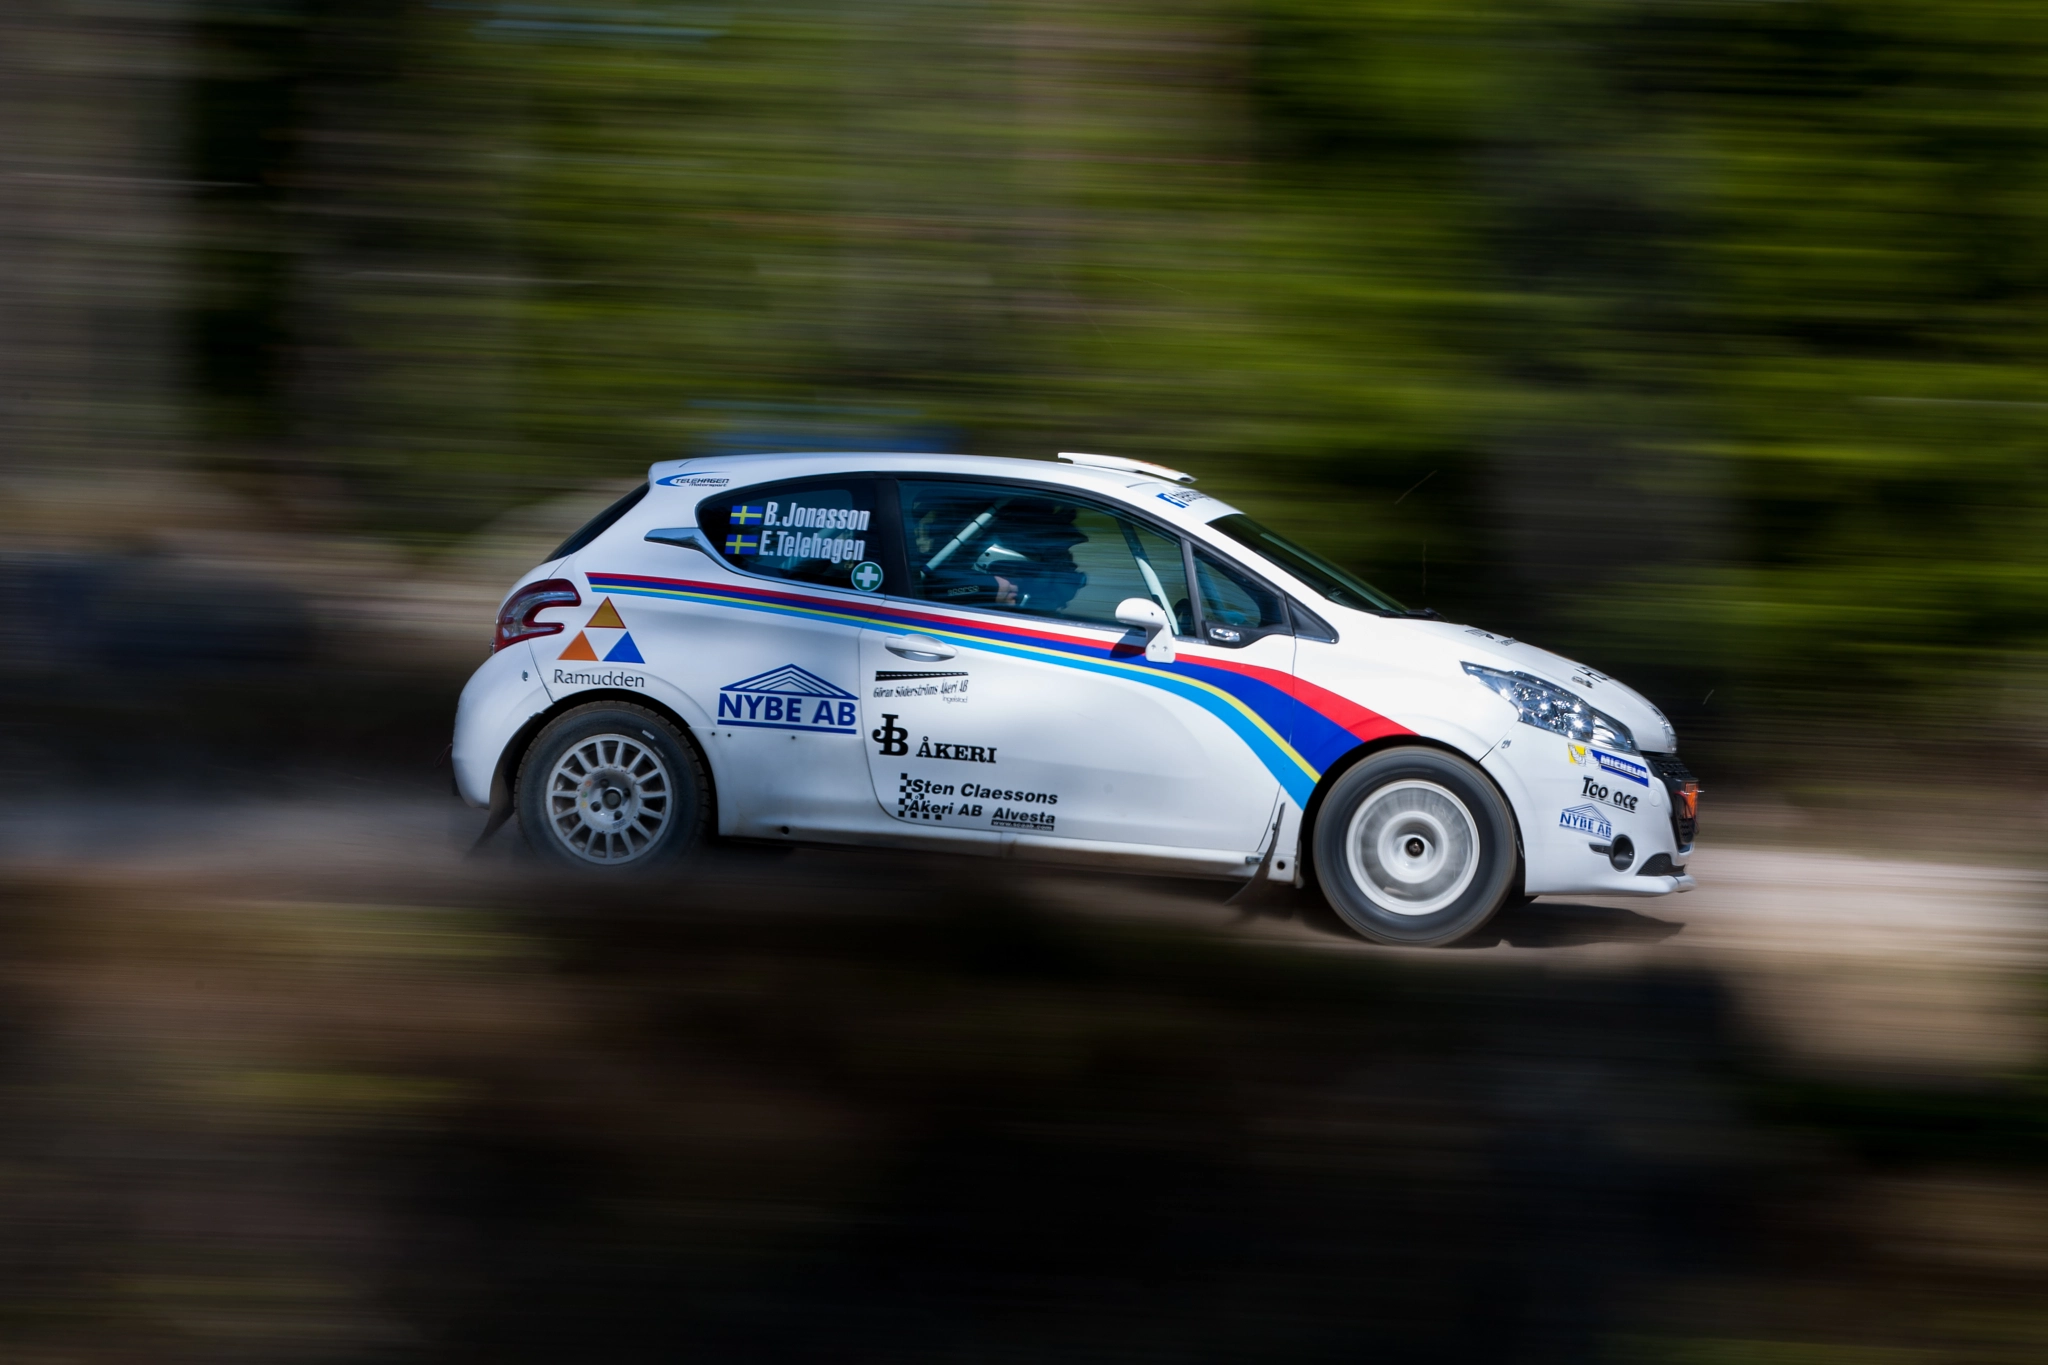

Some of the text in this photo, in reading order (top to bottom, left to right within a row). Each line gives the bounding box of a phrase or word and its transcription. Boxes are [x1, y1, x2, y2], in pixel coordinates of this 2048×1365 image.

[553, 668, 645, 688] Ramudden
[718, 693, 856, 726] NYBE AB
[916, 736, 997, 764] ÅKERI
[1600, 754, 1648, 779] MICHELIN
[911, 779, 1058, 805] Sten Claessons
[907, 795, 1056, 824] Åkeri AB Alvesta
